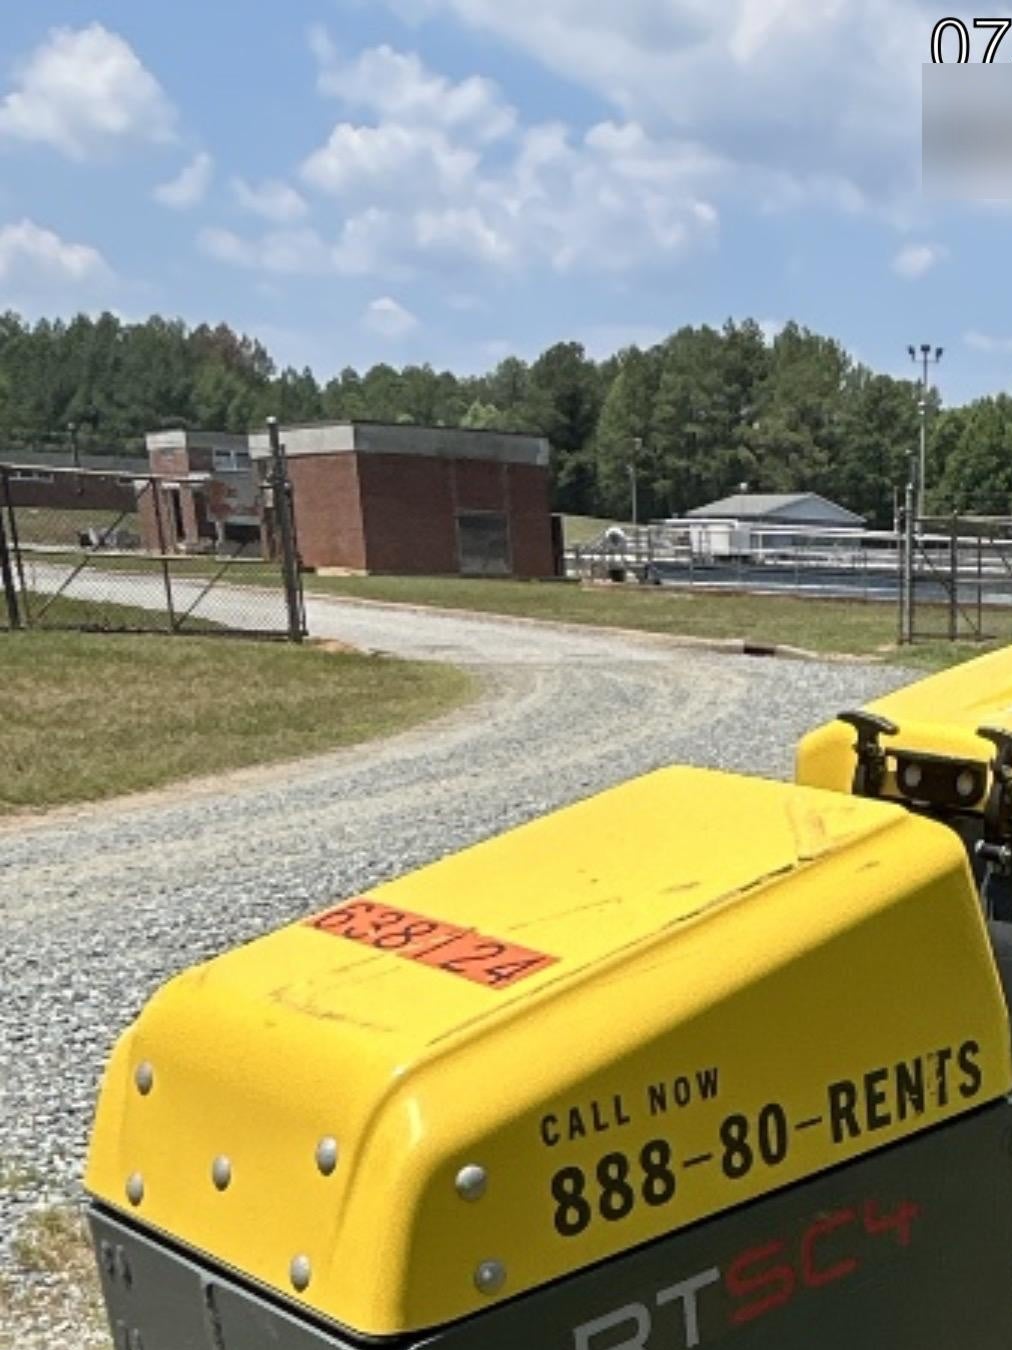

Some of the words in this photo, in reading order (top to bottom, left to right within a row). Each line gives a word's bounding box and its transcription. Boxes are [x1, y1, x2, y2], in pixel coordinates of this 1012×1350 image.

[313, 901, 549, 985] 638124
[540, 1094, 630, 1147] CALL
[647, 1066, 719, 1117] NOW
[550, 1040, 983, 1237] 888-80-RENTS
